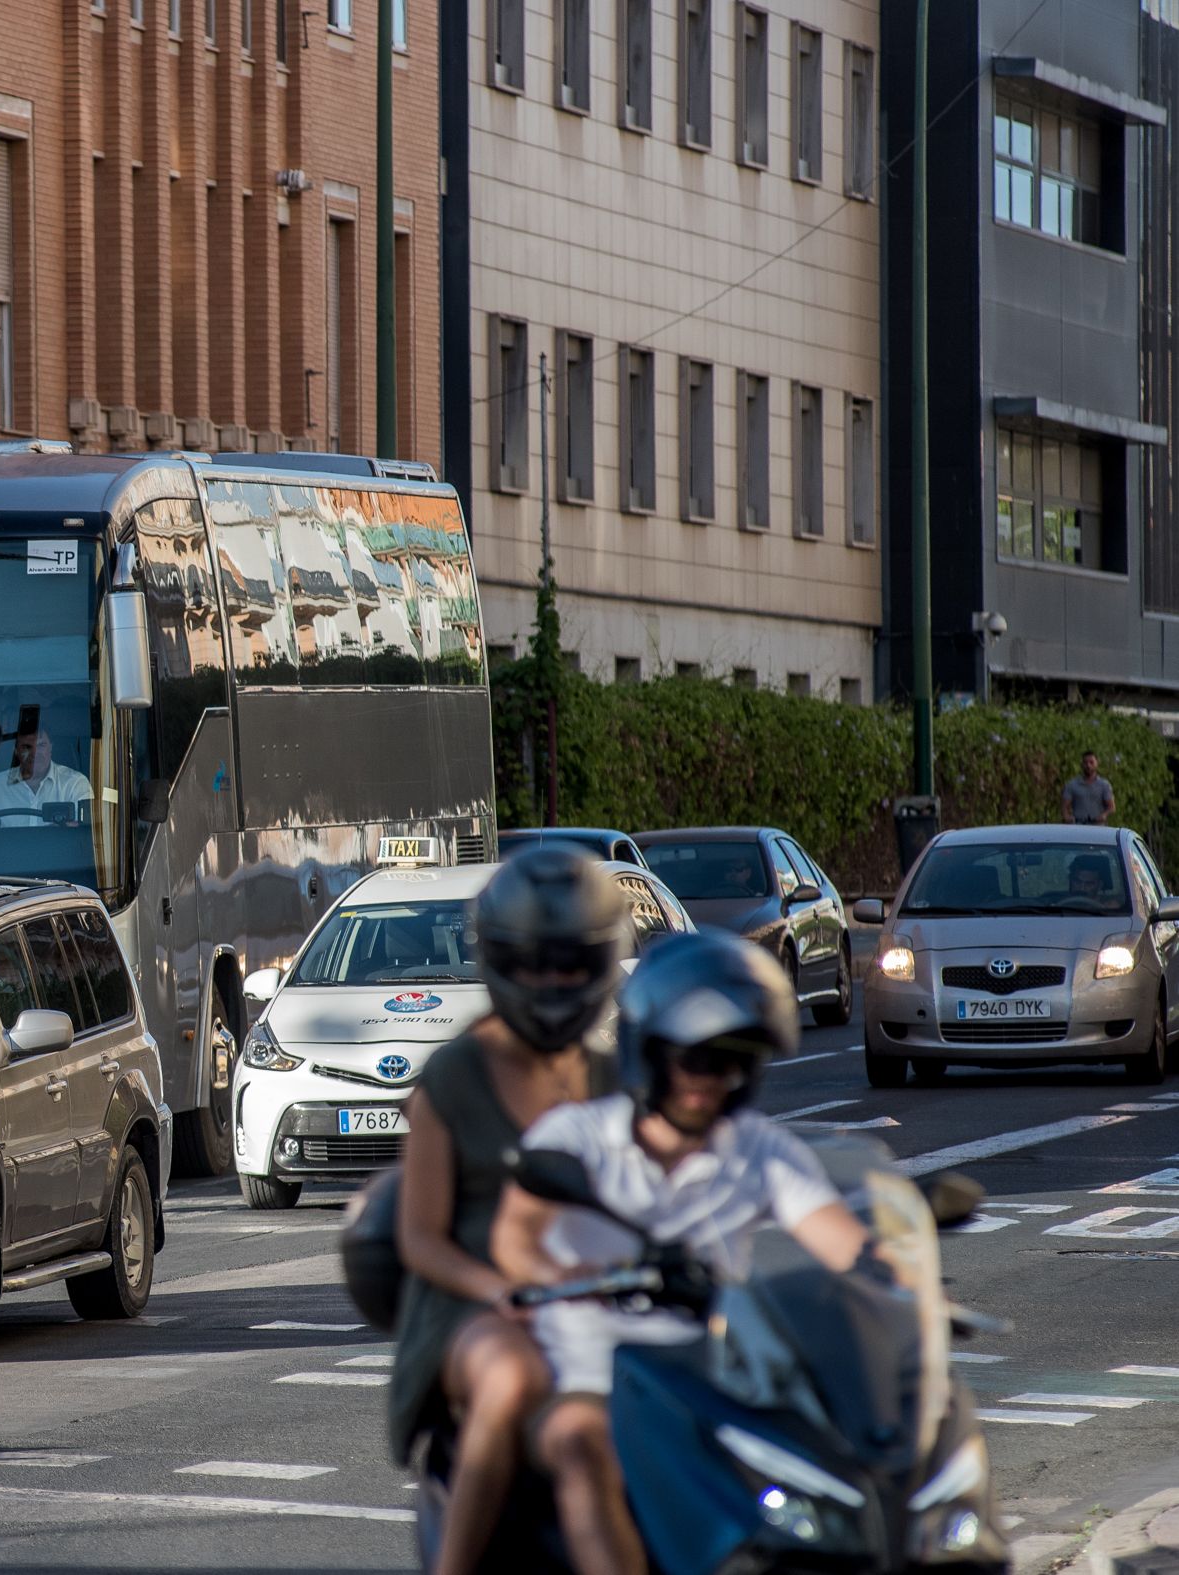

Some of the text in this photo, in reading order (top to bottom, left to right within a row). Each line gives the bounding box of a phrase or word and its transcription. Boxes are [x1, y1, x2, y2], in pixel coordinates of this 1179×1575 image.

[53, 551, 75, 565] TP
[389, 840, 419, 856] TAXI
[970, 1001, 1044, 1016] 7940 DYK
[353, 1112, 401, 1130] 7687
